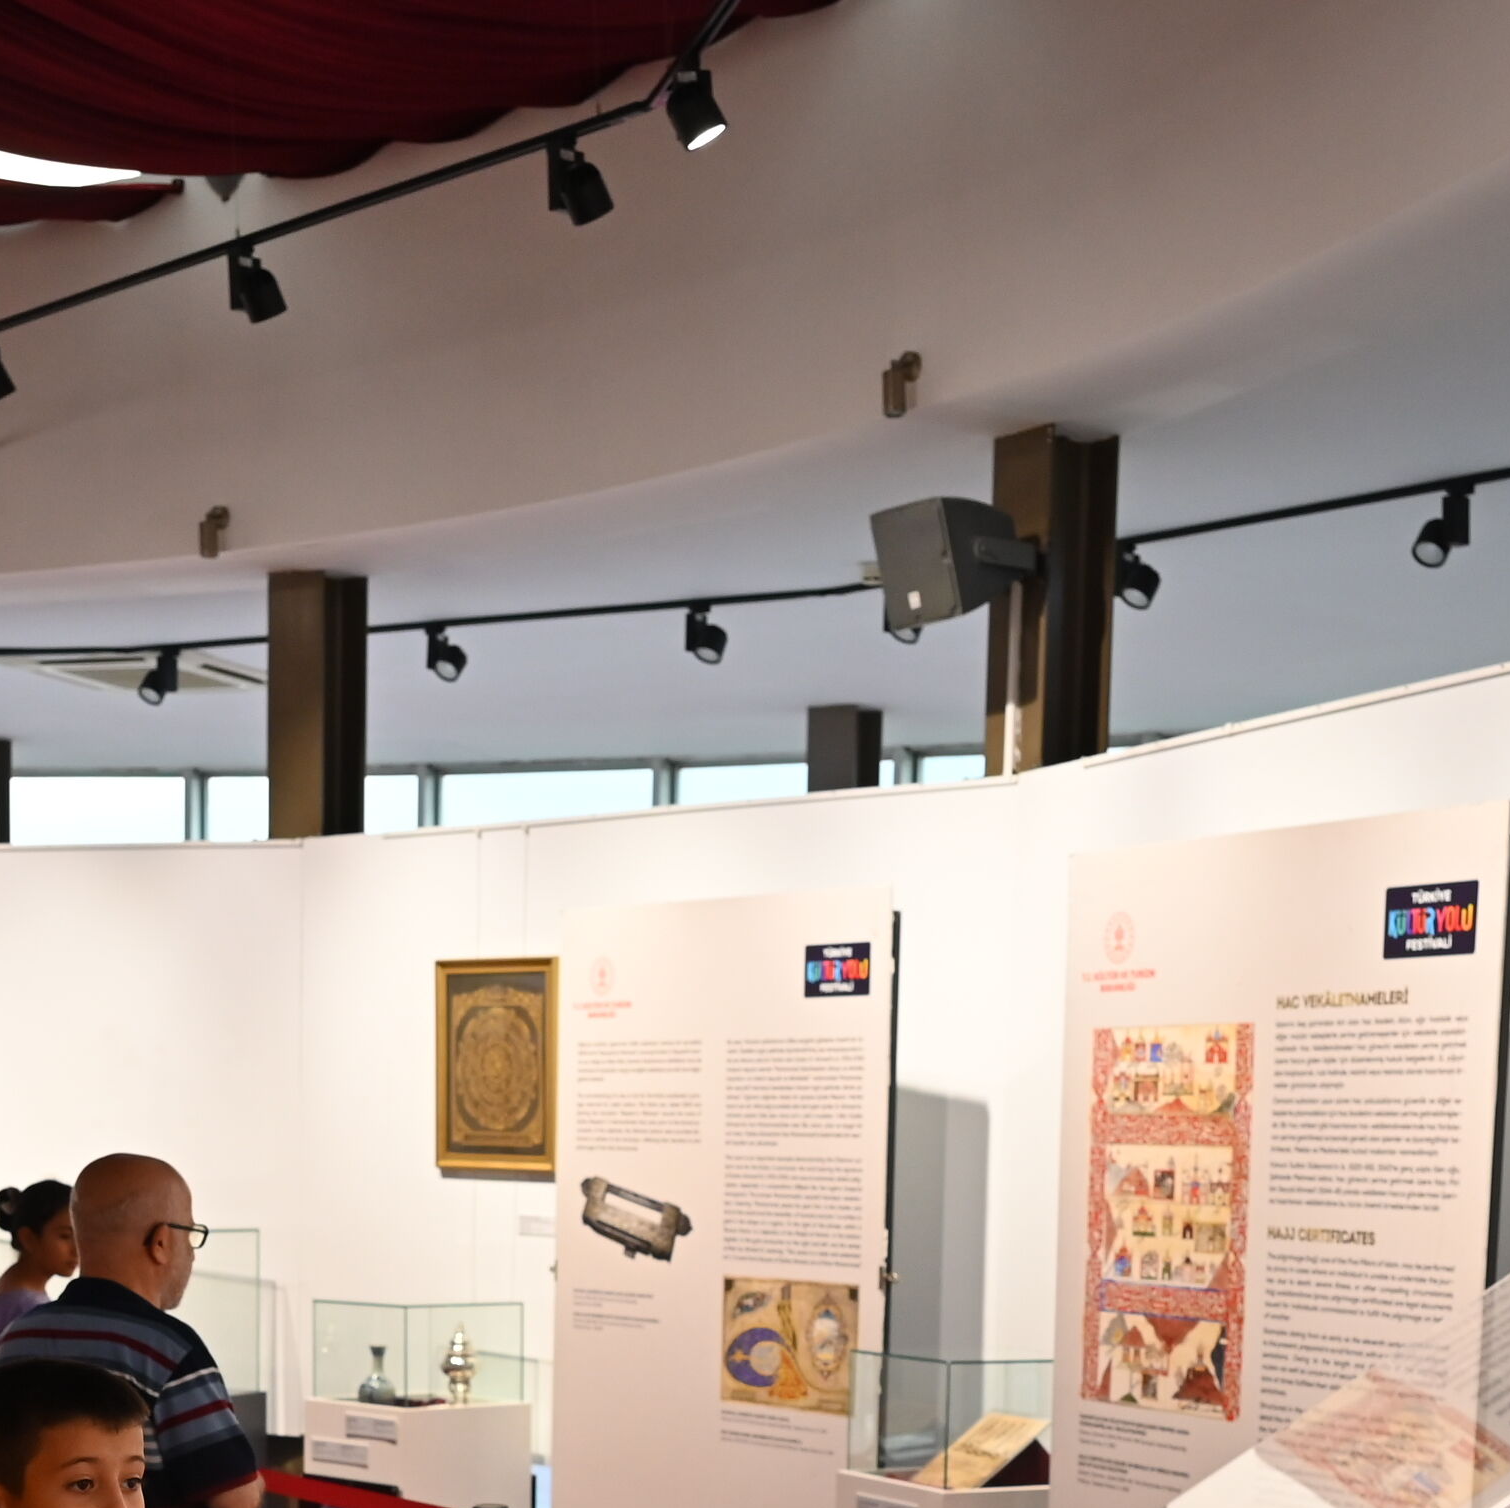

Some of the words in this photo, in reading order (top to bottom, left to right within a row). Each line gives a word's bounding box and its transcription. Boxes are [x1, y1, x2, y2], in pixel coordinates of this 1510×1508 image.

[1387, 905, 1436, 939] KÜLTÜR
[1436, 903, 1474, 932] YOLU
[1267, 1226, 1295, 1242] HAJJ
[1297, 1228, 1376, 1246] CERTIFICATES
